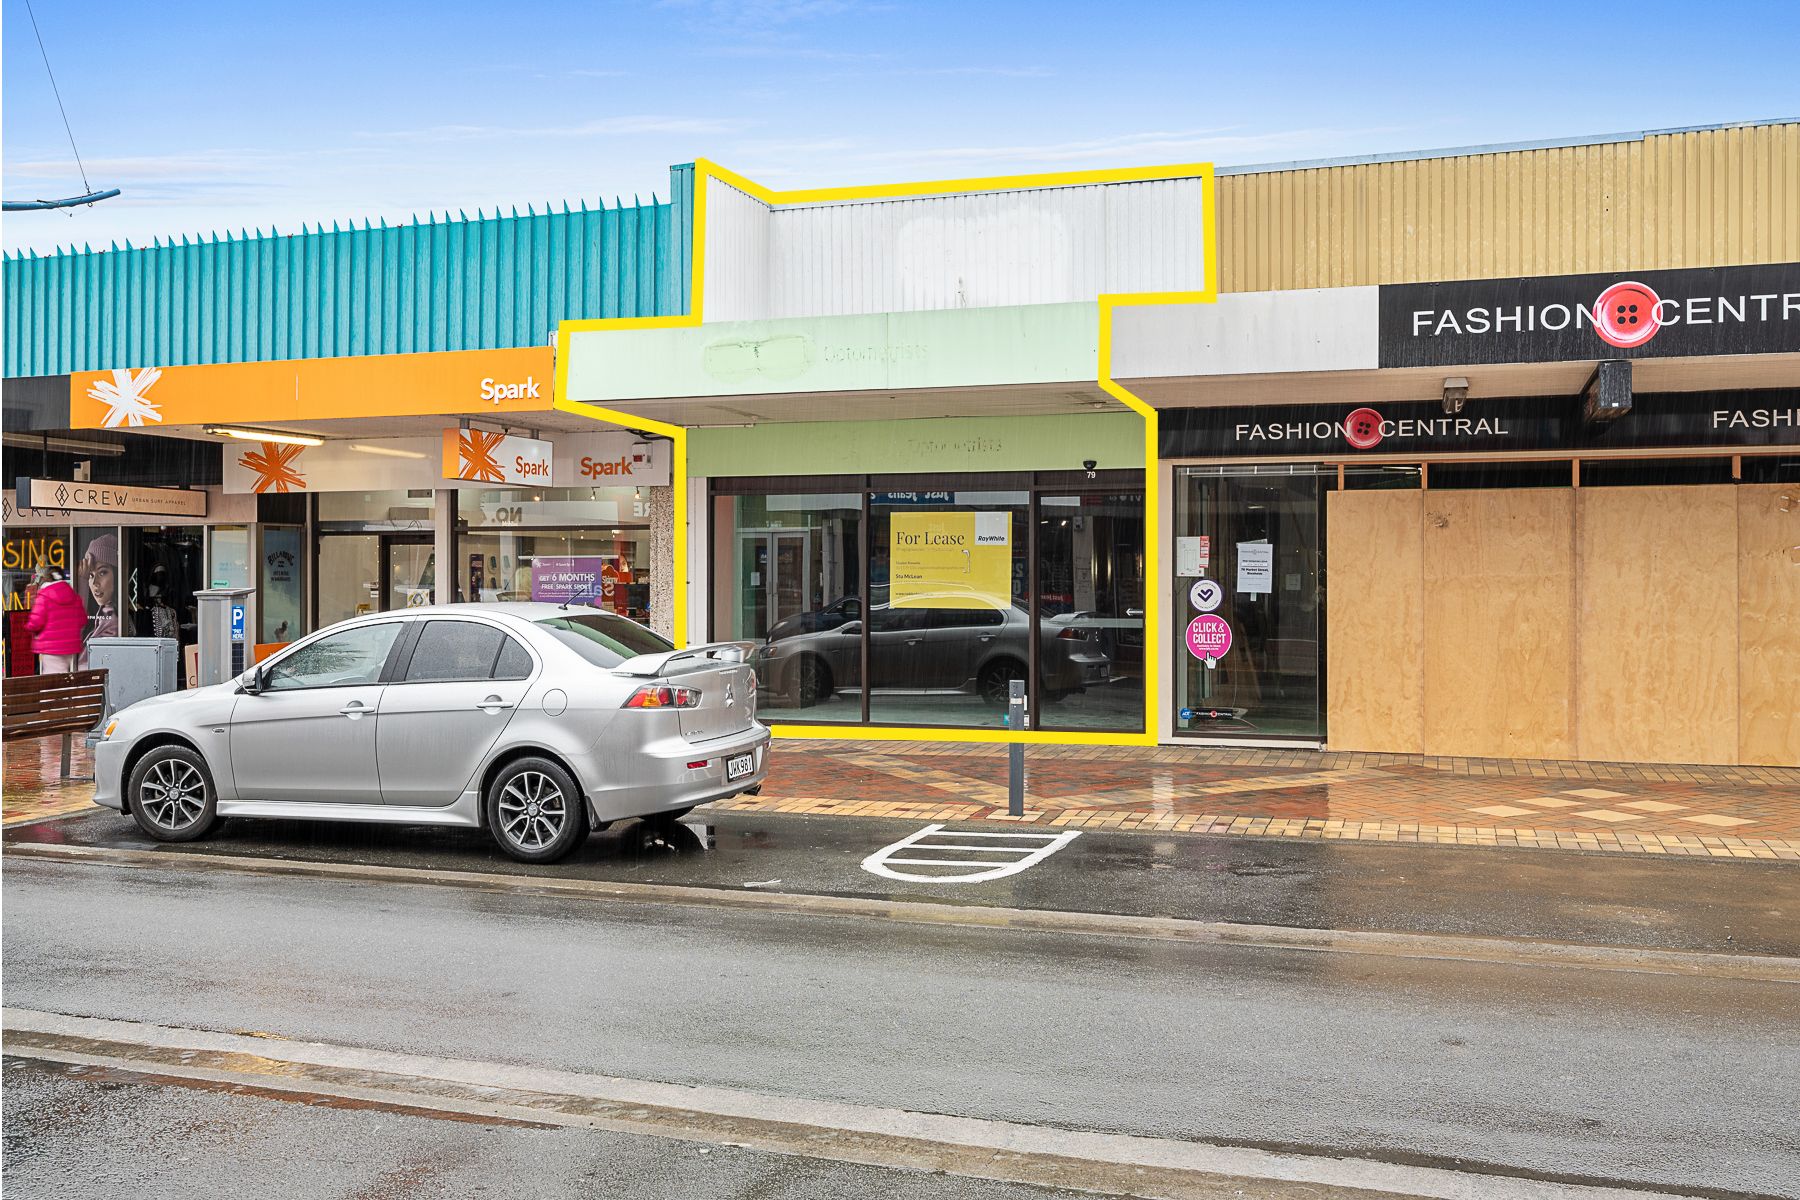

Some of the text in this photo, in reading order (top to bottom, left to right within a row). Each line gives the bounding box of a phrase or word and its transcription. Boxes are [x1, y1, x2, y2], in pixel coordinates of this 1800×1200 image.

[1412, 301, 1602, 337] FASHION
[480, 376, 540, 405] Spark
[1236, 417, 1509, 440] FASHION CENTRAL
[516, 456, 549, 478] Spark
[580, 456, 633, 479] Spark
[1086, 471, 1096, 479] 79
[73, 489, 128, 506] CREW
[896, 531, 965, 545] For Lease
[2, 538, 64, 569] SING
[559, 573, 595, 582] MONTHS
[233, 608, 243, 626] P
[1192, 622, 1225, 633] CLICK &
[1193, 633, 1226, 644] COLLECT
